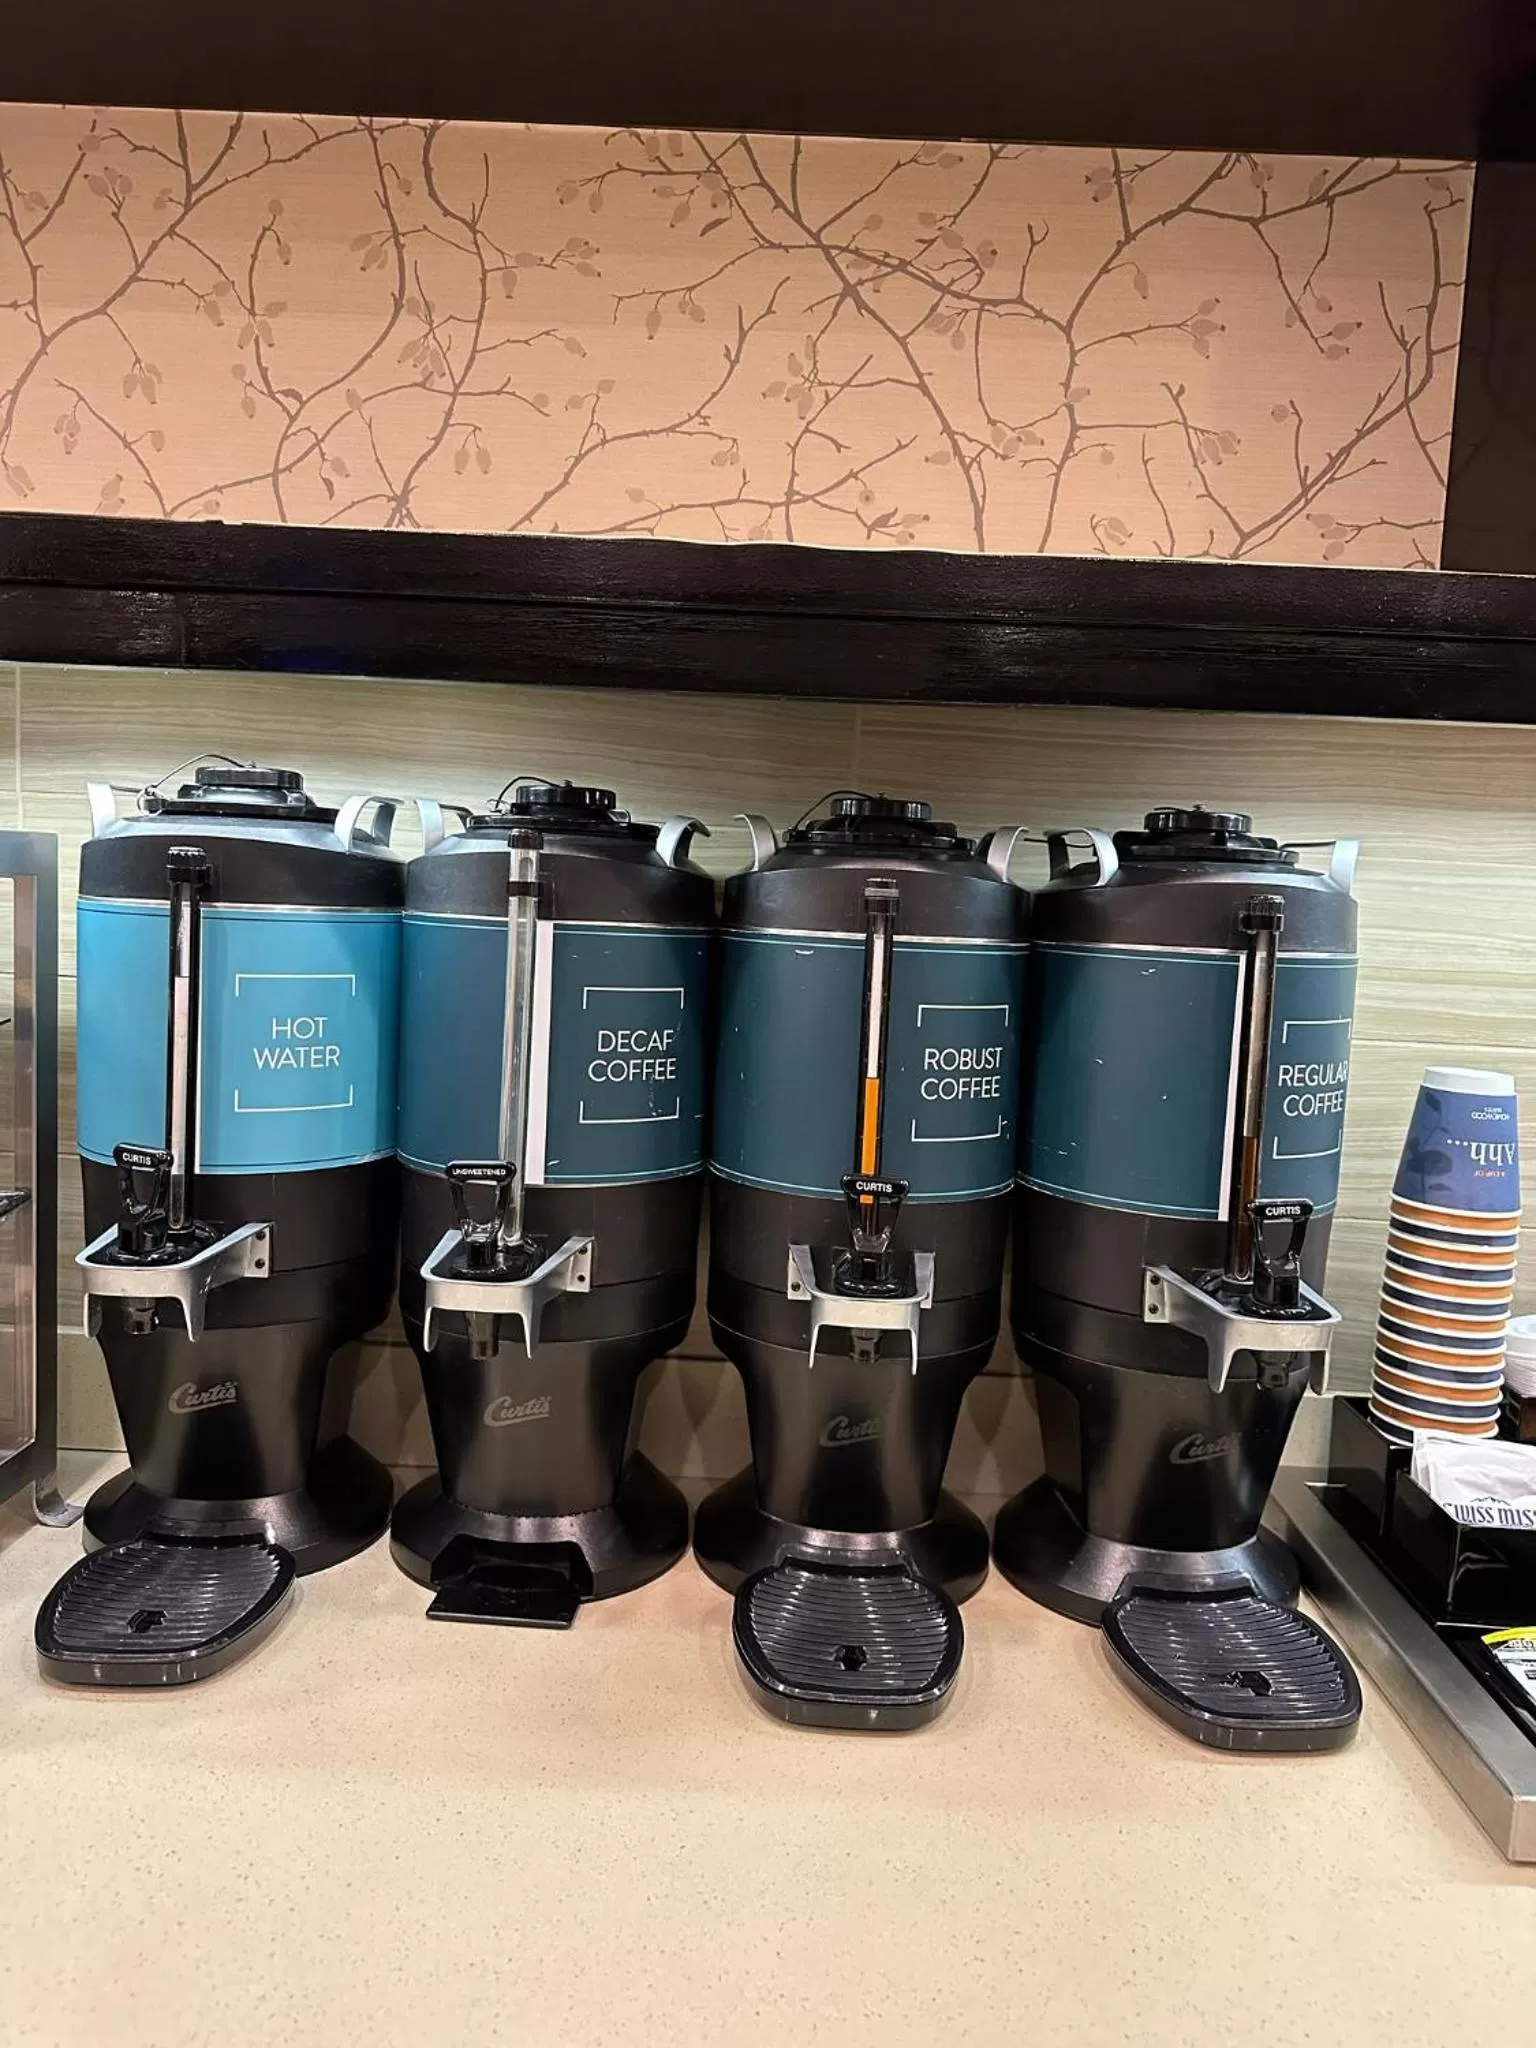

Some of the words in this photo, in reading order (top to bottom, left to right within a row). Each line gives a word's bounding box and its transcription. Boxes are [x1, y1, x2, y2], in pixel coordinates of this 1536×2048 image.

[272, 1017, 328, 1039] HOT
[598, 1029, 674, 1052] DECAF
[253, 1045, 340, 1070] WATER
[924, 1047, 1003, 1071] ROBUST
[588, 1058, 676, 1082] COFFEE
[1278, 1060, 1347, 1087] REGULAR
[921, 1076, 1001, 1100] COFFEE
[1283, 1090, 1344, 1117] COFFEE
[122, 1152, 151, 1165] CURTIS
[855, 1180, 893, 1193] CURTIS
[1265, 1205, 1301, 1216] CURTIS
[168, 1382, 238, 1414] Curtis
[484, 1395, 552, 1427] Curtis
